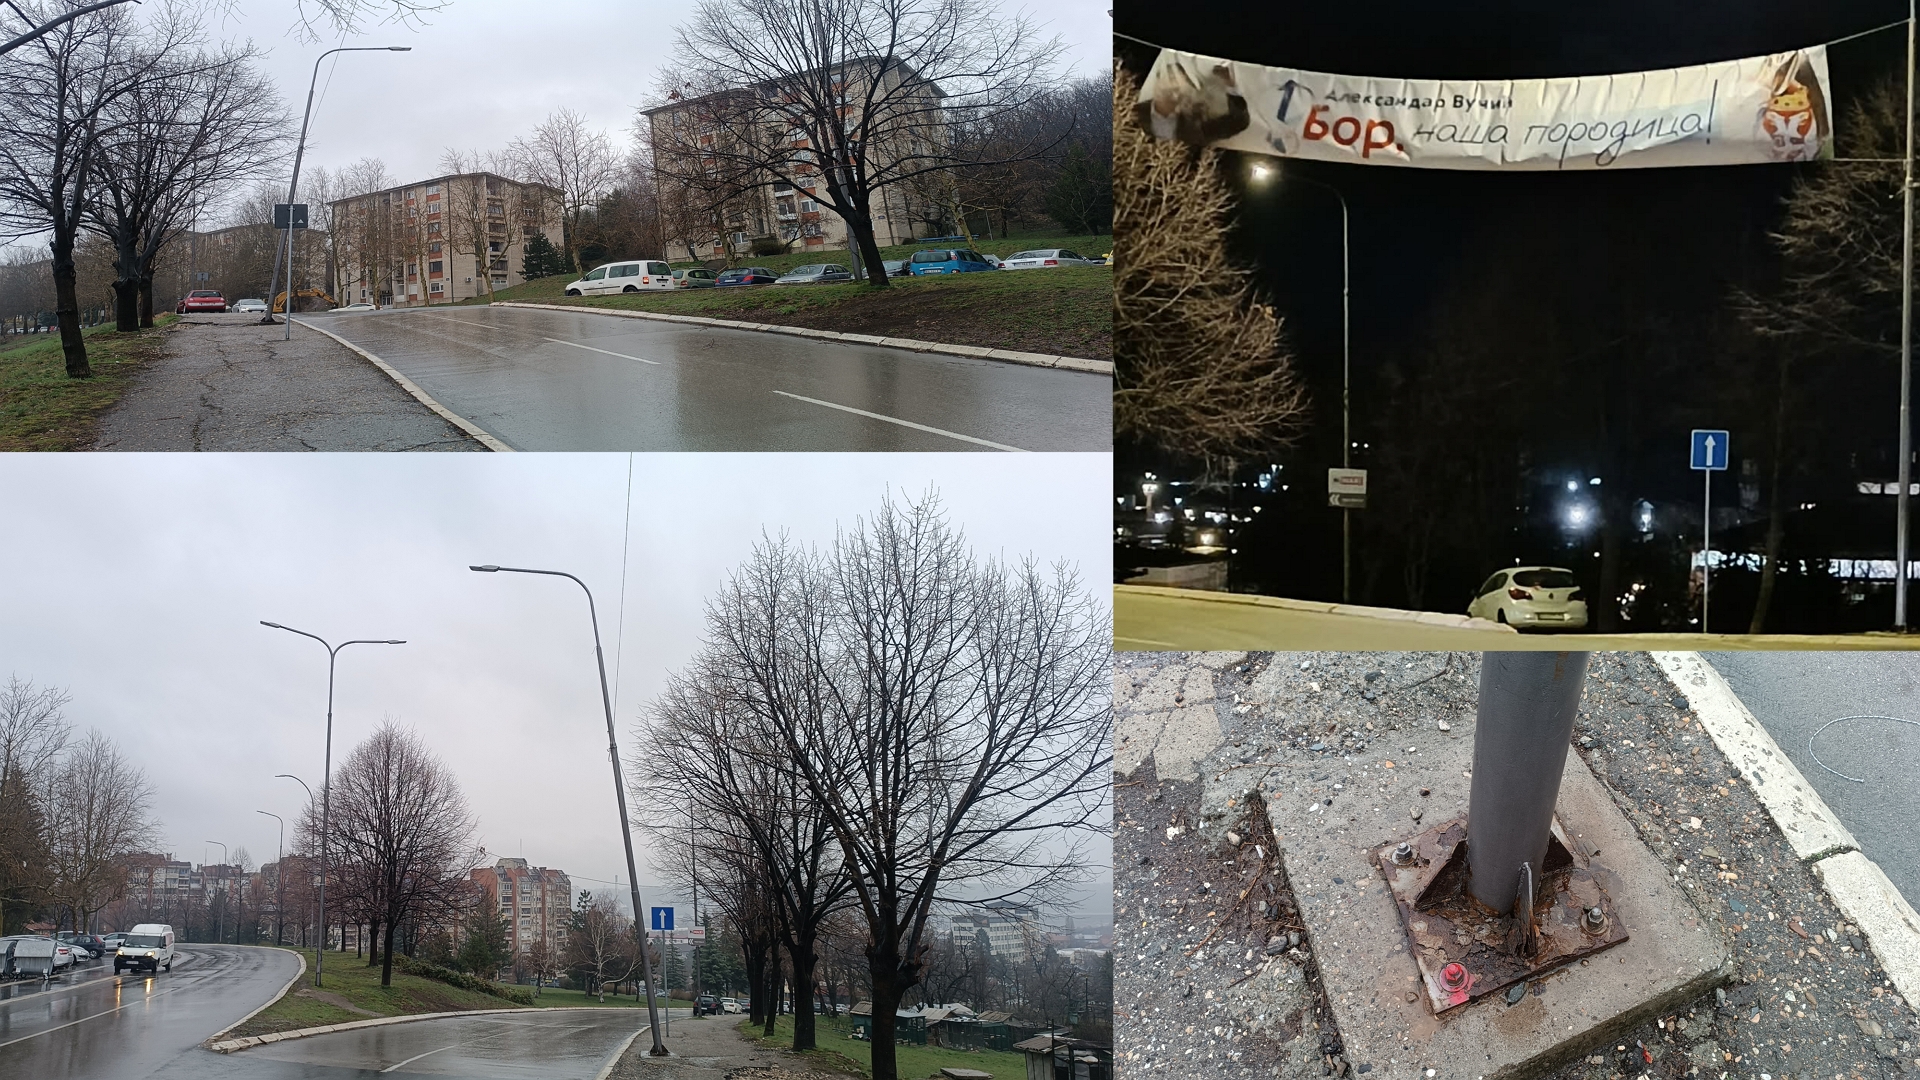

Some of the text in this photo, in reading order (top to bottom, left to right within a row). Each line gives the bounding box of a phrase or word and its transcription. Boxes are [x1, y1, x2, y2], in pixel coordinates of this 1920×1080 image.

[1303, 79, 1718, 169] Бор. наша породица!
[1325, 90, 1446, 112] Александар
